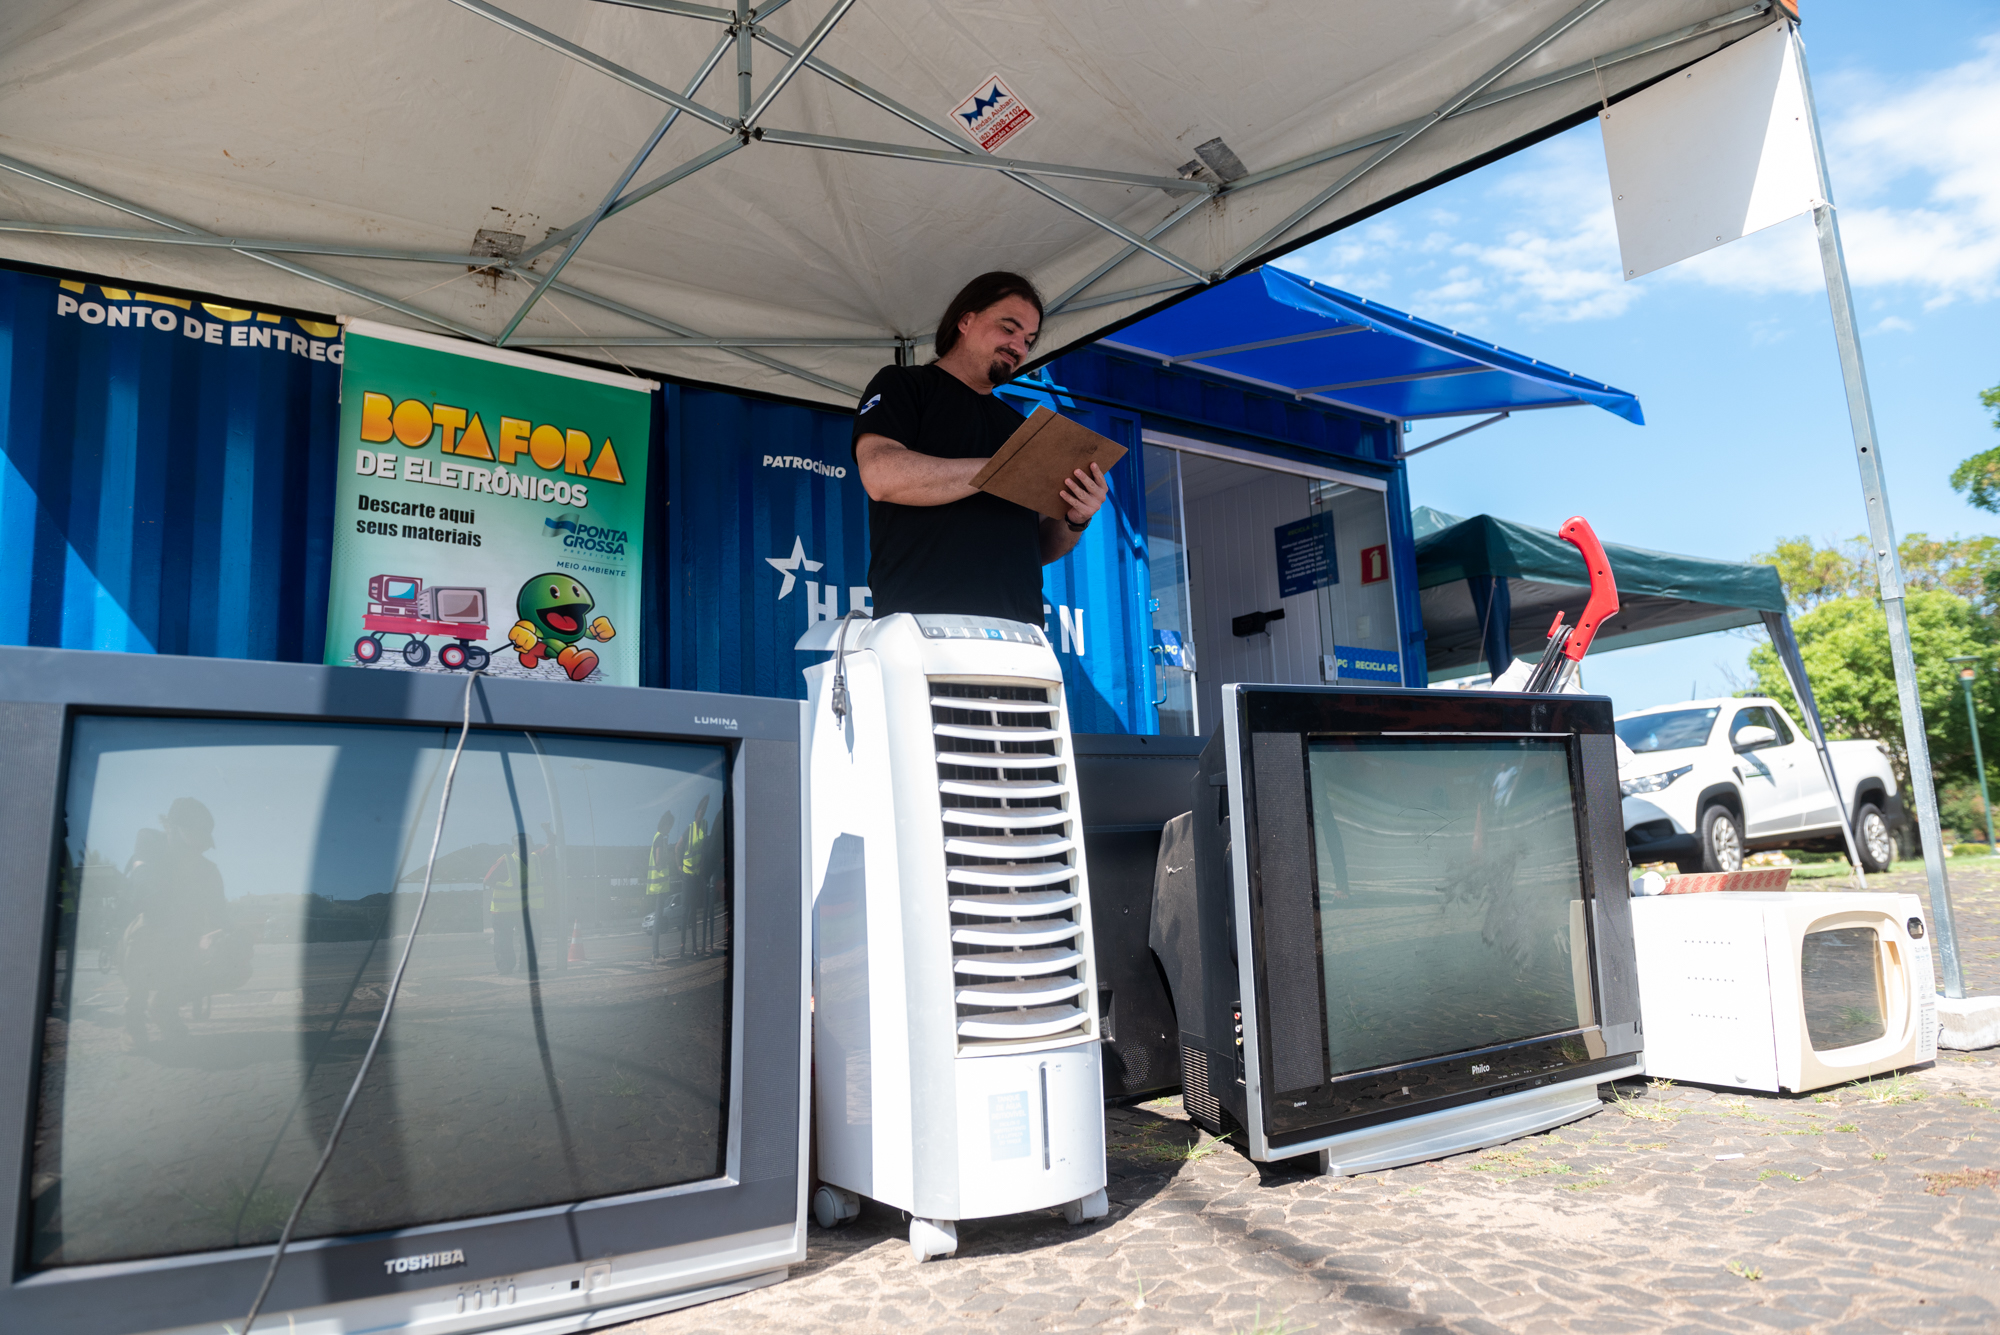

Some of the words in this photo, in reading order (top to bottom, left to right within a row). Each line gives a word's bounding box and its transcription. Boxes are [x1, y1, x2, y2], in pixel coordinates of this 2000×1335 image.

[970, 116, 992, 133] Tendas
[991, 98, 1014, 118] Aluban
[979, 132, 991, 141] (62)
[989, 105, 1022, 133] 3298-7102
[984, 130, 1006, 148] LOCAÇÃO
[1009, 112, 1028, 128] VENDAS
[57, 294, 178, 332] PONTO
[183, 315, 225, 345] DE
[230, 326, 345, 365] ENTREG
[360, 390, 497, 462] BOTA
[498, 415, 626, 485] FORA
[355, 449, 398, 479] DE
[403, 455, 588, 508] ELETRÔNICOS
[762, 454, 847, 479] PATROCÍNIO
[357, 494, 436, 519] Descarte
[439, 504, 475, 525] aqui
[356, 519, 398, 538] seus
[401, 523, 482, 548] materiais
[563, 534, 625, 555] GROSSA
[577, 523, 628, 543] PONTA
[563, 548, 624, 561] PREFEITURA
[556, 561, 580, 570] MEIO
[581, 565, 626, 577] AMBIENTE
[1165, 644, 1178, 655] PG
[1337, 659, 1348, 668] PG
[1355, 660, 1386, 672] RECICLA
[1387, 663, 1398, 673] PG
[694, 716, 738, 726] LUMINA
[1471, 1064, 1490, 1075] Philco
[384, 1249, 465, 1275] TOSHIBA
